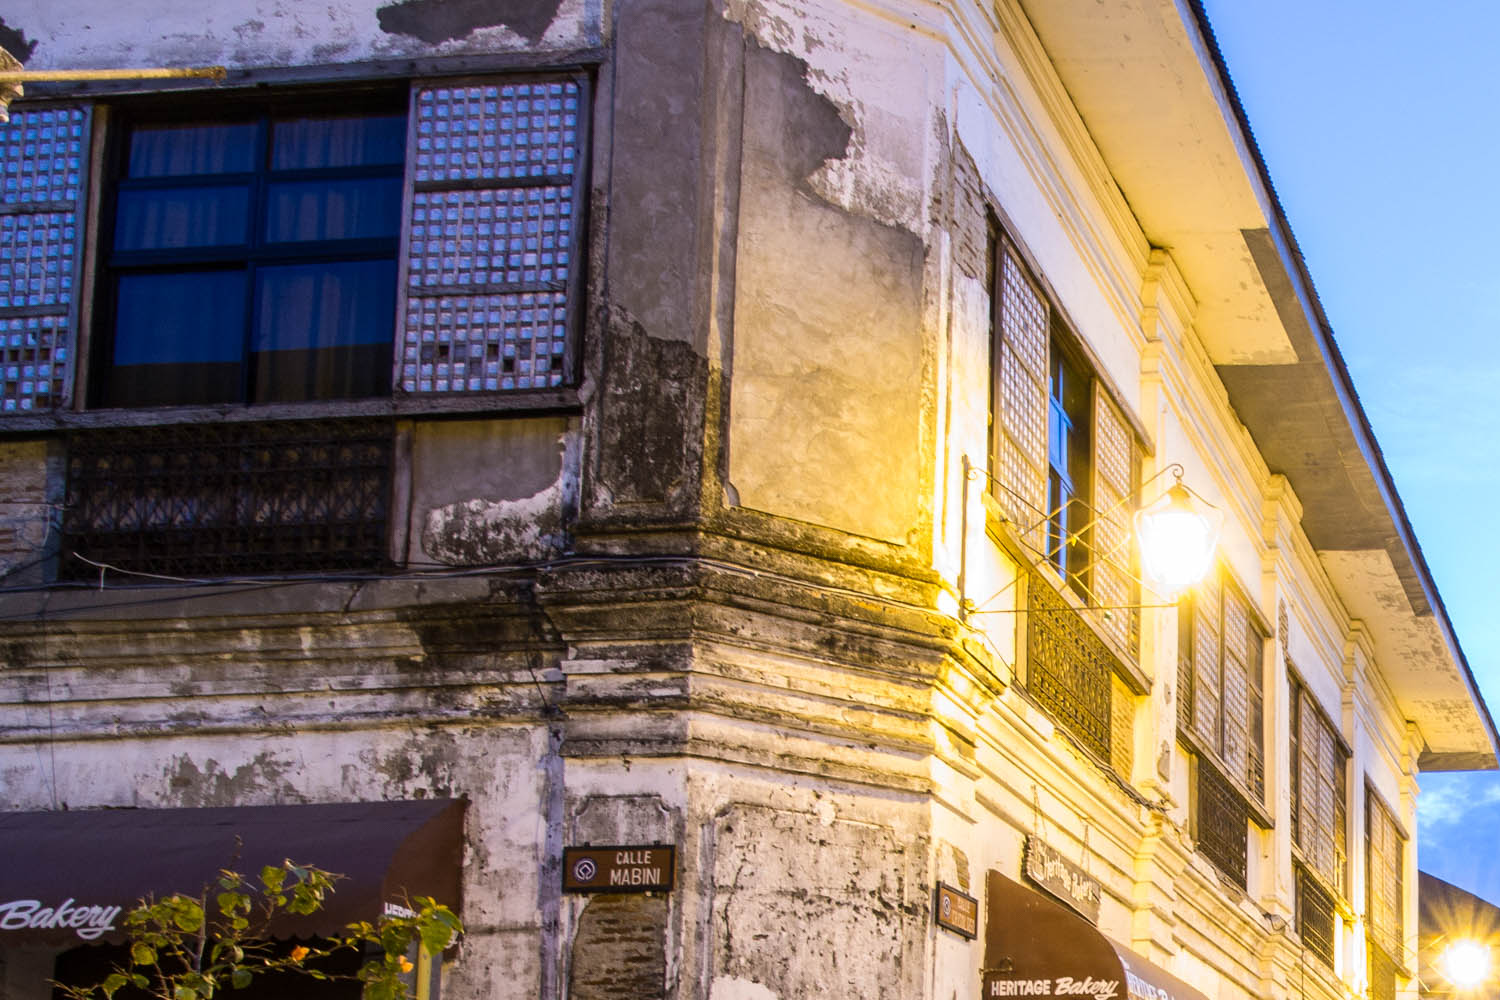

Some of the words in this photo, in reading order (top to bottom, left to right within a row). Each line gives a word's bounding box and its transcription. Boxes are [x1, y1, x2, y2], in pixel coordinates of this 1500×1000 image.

[616, 850, 652, 865] CALLE
[610, 867, 661, 886] MABINI
[0, 898, 122, 940] Bakery
[991, 979, 1052, 996] HERITAGE
[1055, 976, 1120, 1000] Bakery
